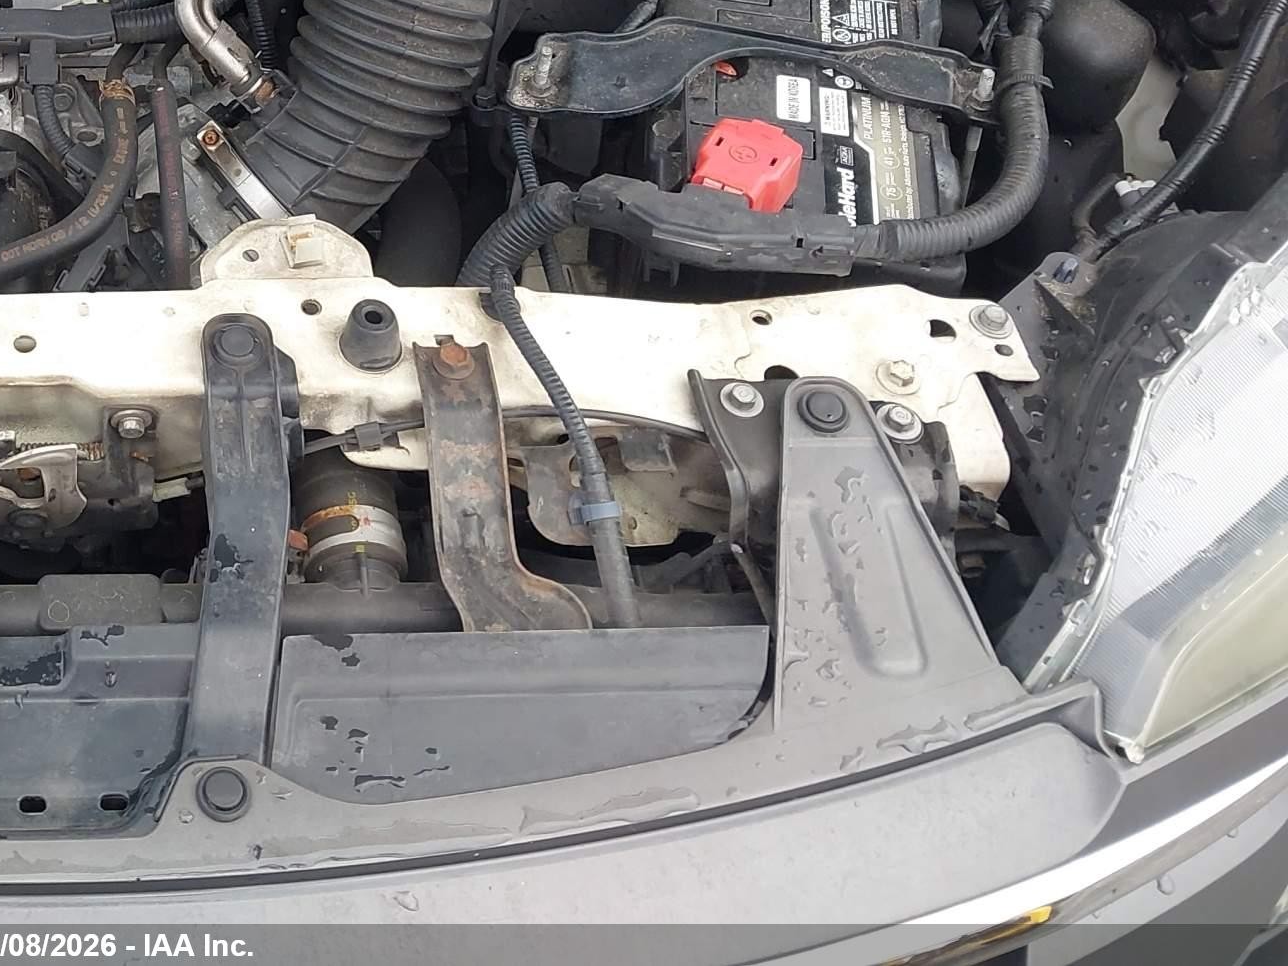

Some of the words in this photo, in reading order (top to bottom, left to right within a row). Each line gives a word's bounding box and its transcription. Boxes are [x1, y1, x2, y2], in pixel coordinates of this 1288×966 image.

[861, 97, 873, 139] PLATINUM
[885, 157, 894, 166] 41
[887, 187, 896, 197] 75
